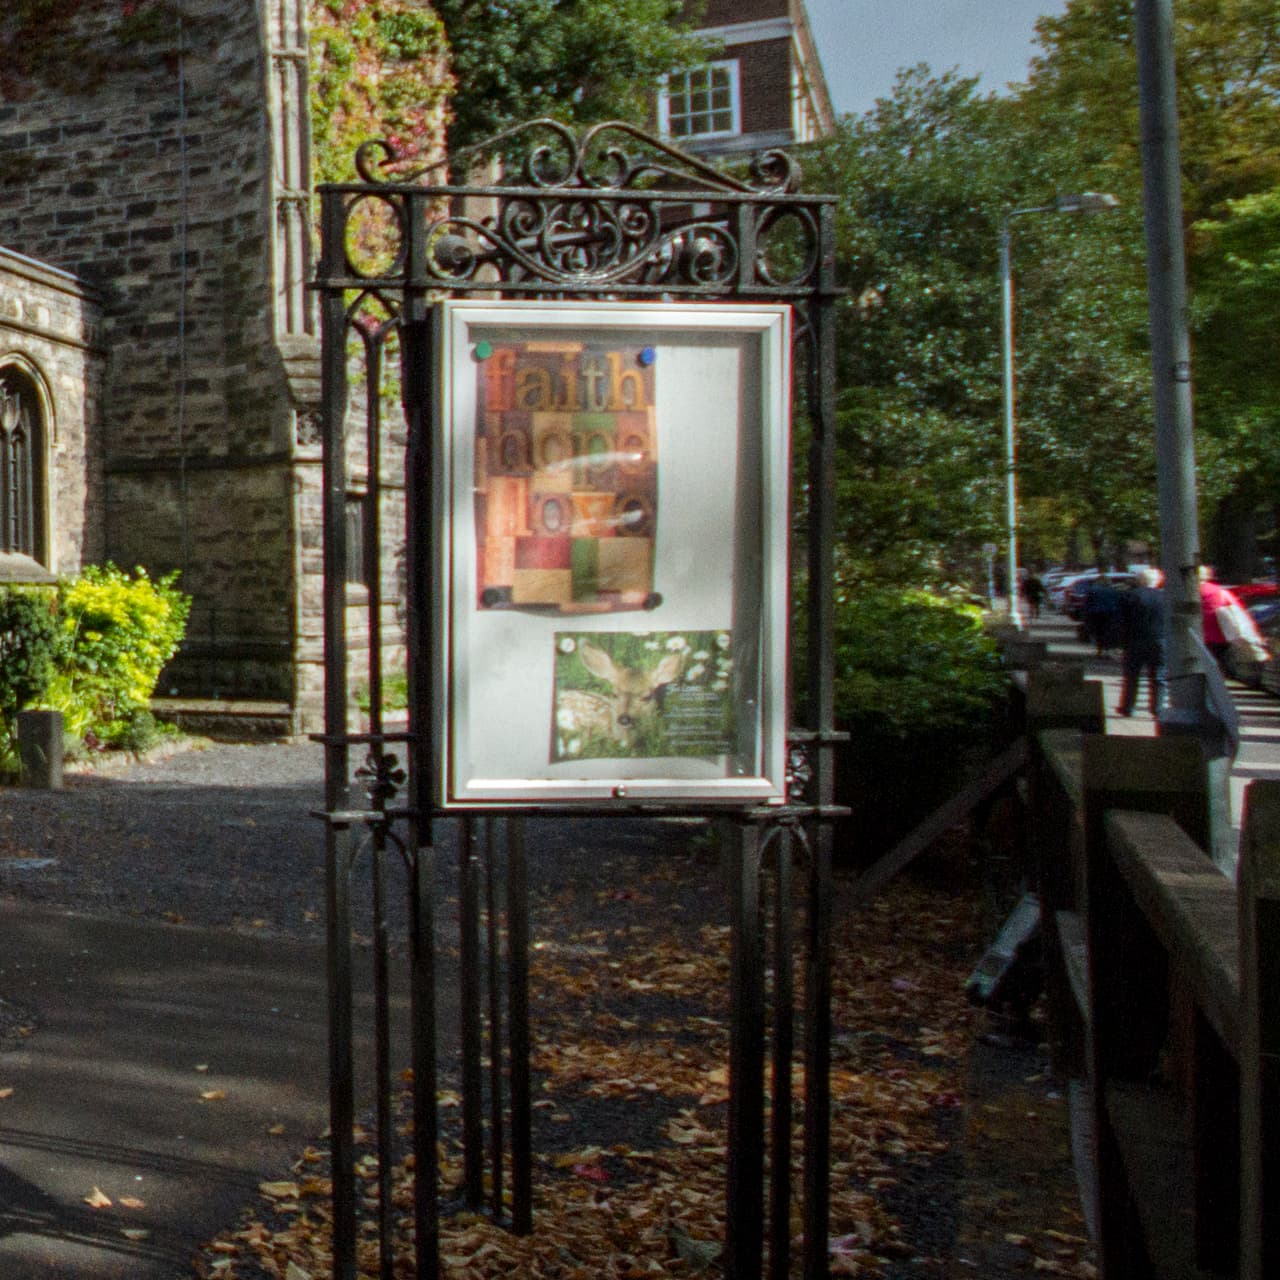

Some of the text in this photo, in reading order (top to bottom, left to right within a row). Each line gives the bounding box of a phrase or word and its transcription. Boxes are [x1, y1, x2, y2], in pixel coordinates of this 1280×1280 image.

[485, 350, 650, 411] faith
[486, 412, 650, 489] hope
[487, 476, 654, 538] love
